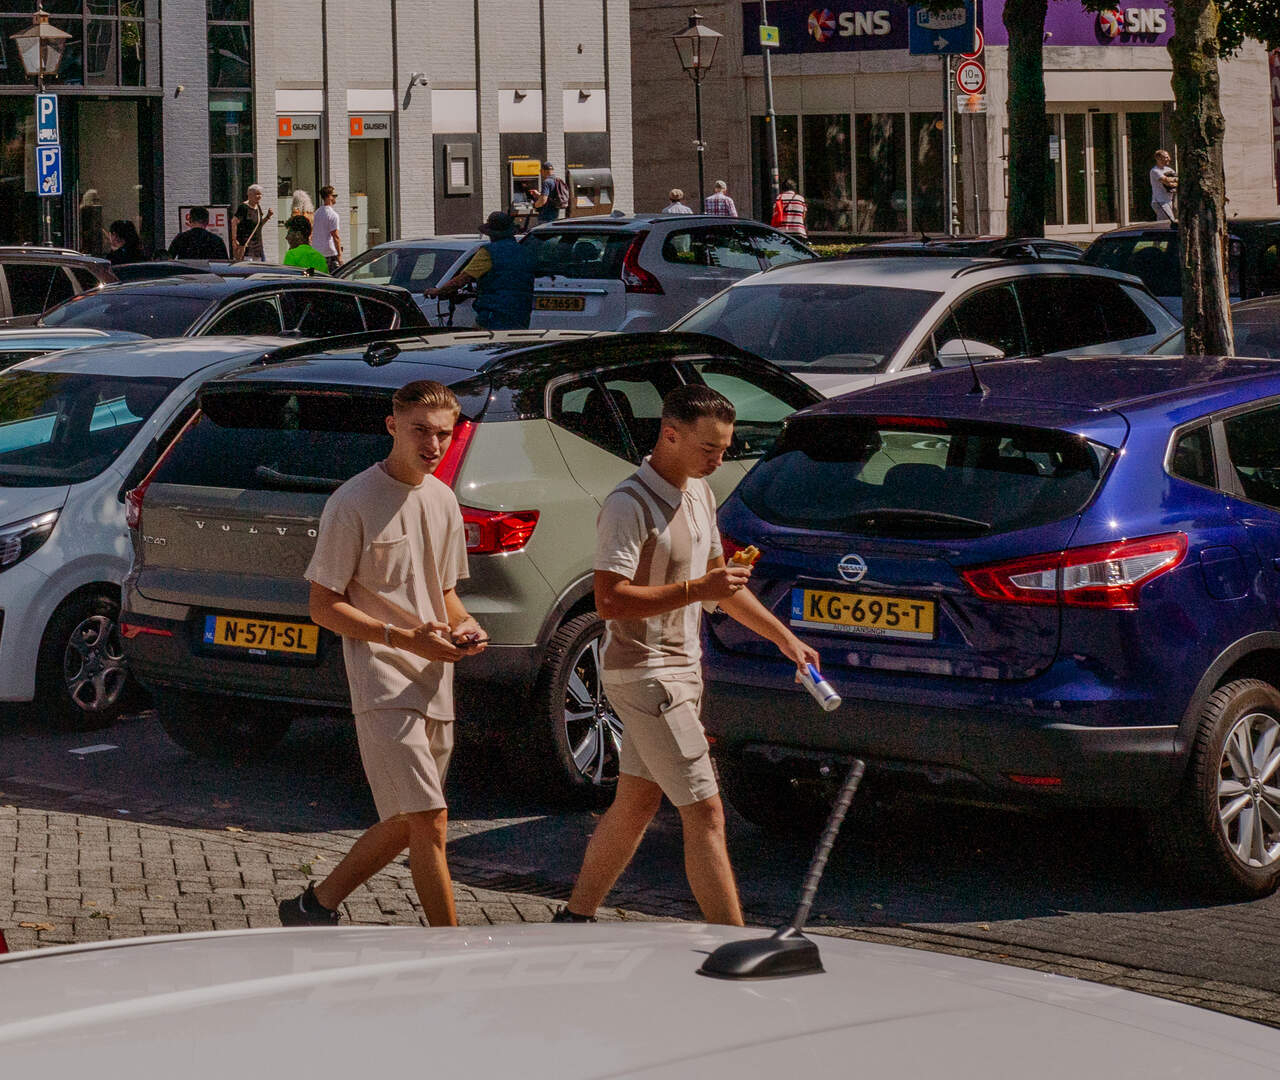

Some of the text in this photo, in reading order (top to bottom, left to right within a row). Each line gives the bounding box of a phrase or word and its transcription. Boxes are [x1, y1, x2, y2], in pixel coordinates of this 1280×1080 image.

[838, 9, 892, 37] SNS
[1124, 6, 1167, 35] SNS
[965, 69, 974, 79] 10
[40, 98, 53, 124] P
[292, 123, 317, 131] GIJSEN
[41, 150, 56, 175] P
[196, 520, 318, 538] VOLVO
[839, 564, 864, 572] NISSAN
[792, 606, 802, 616] NL
[810, 593, 925, 630] KG-695-T
[204, 631, 214, 640] NL
[224, 620, 308, 650] N-571-SL
